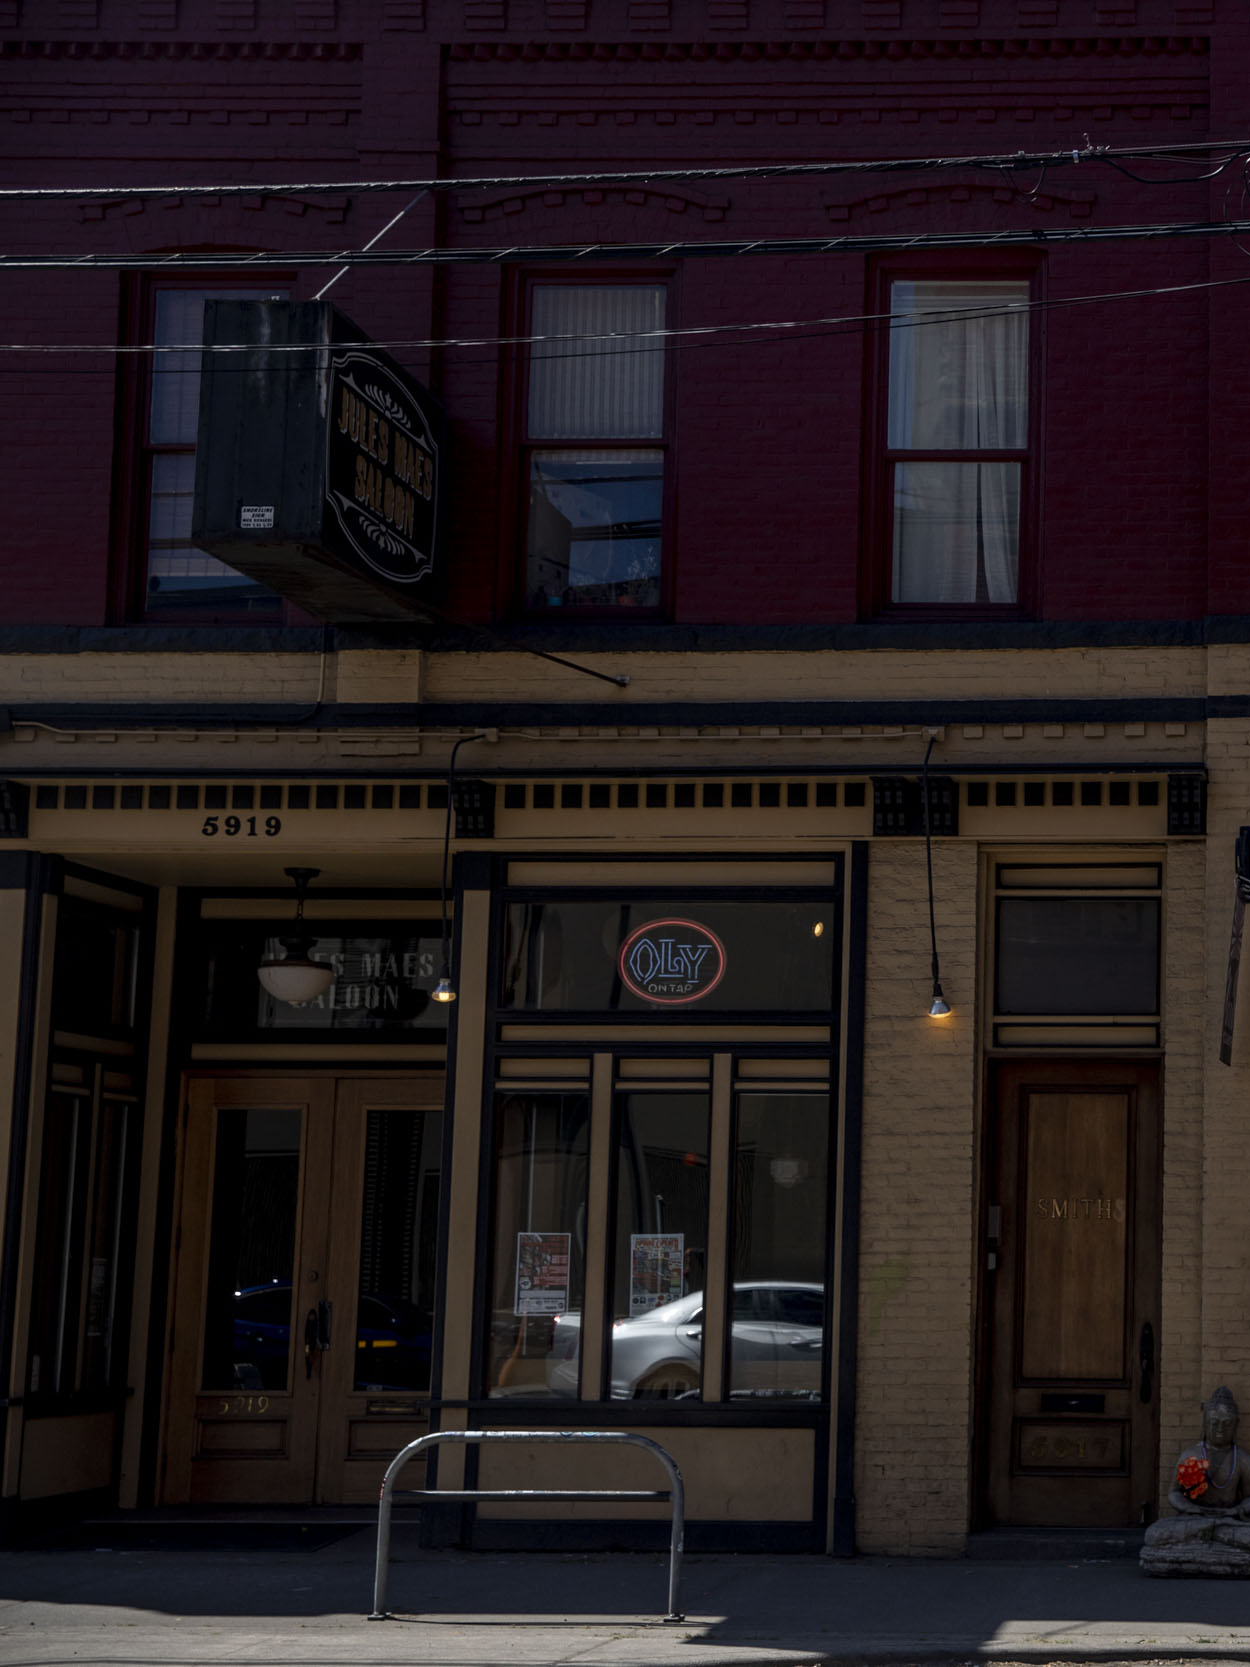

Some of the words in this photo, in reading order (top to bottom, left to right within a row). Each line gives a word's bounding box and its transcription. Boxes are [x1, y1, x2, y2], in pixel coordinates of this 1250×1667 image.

[337, 385, 390, 467] JULES
[394, 430, 433, 501] MAES
[354, 454, 415, 540] SALOON
[202, 816, 281, 836] 5919
[361, 952, 434, 977] MAES
[629, 938, 713, 985] OLY
[291, 984, 400, 1009] ALOON
[669, 983, 694, 993] TAP
